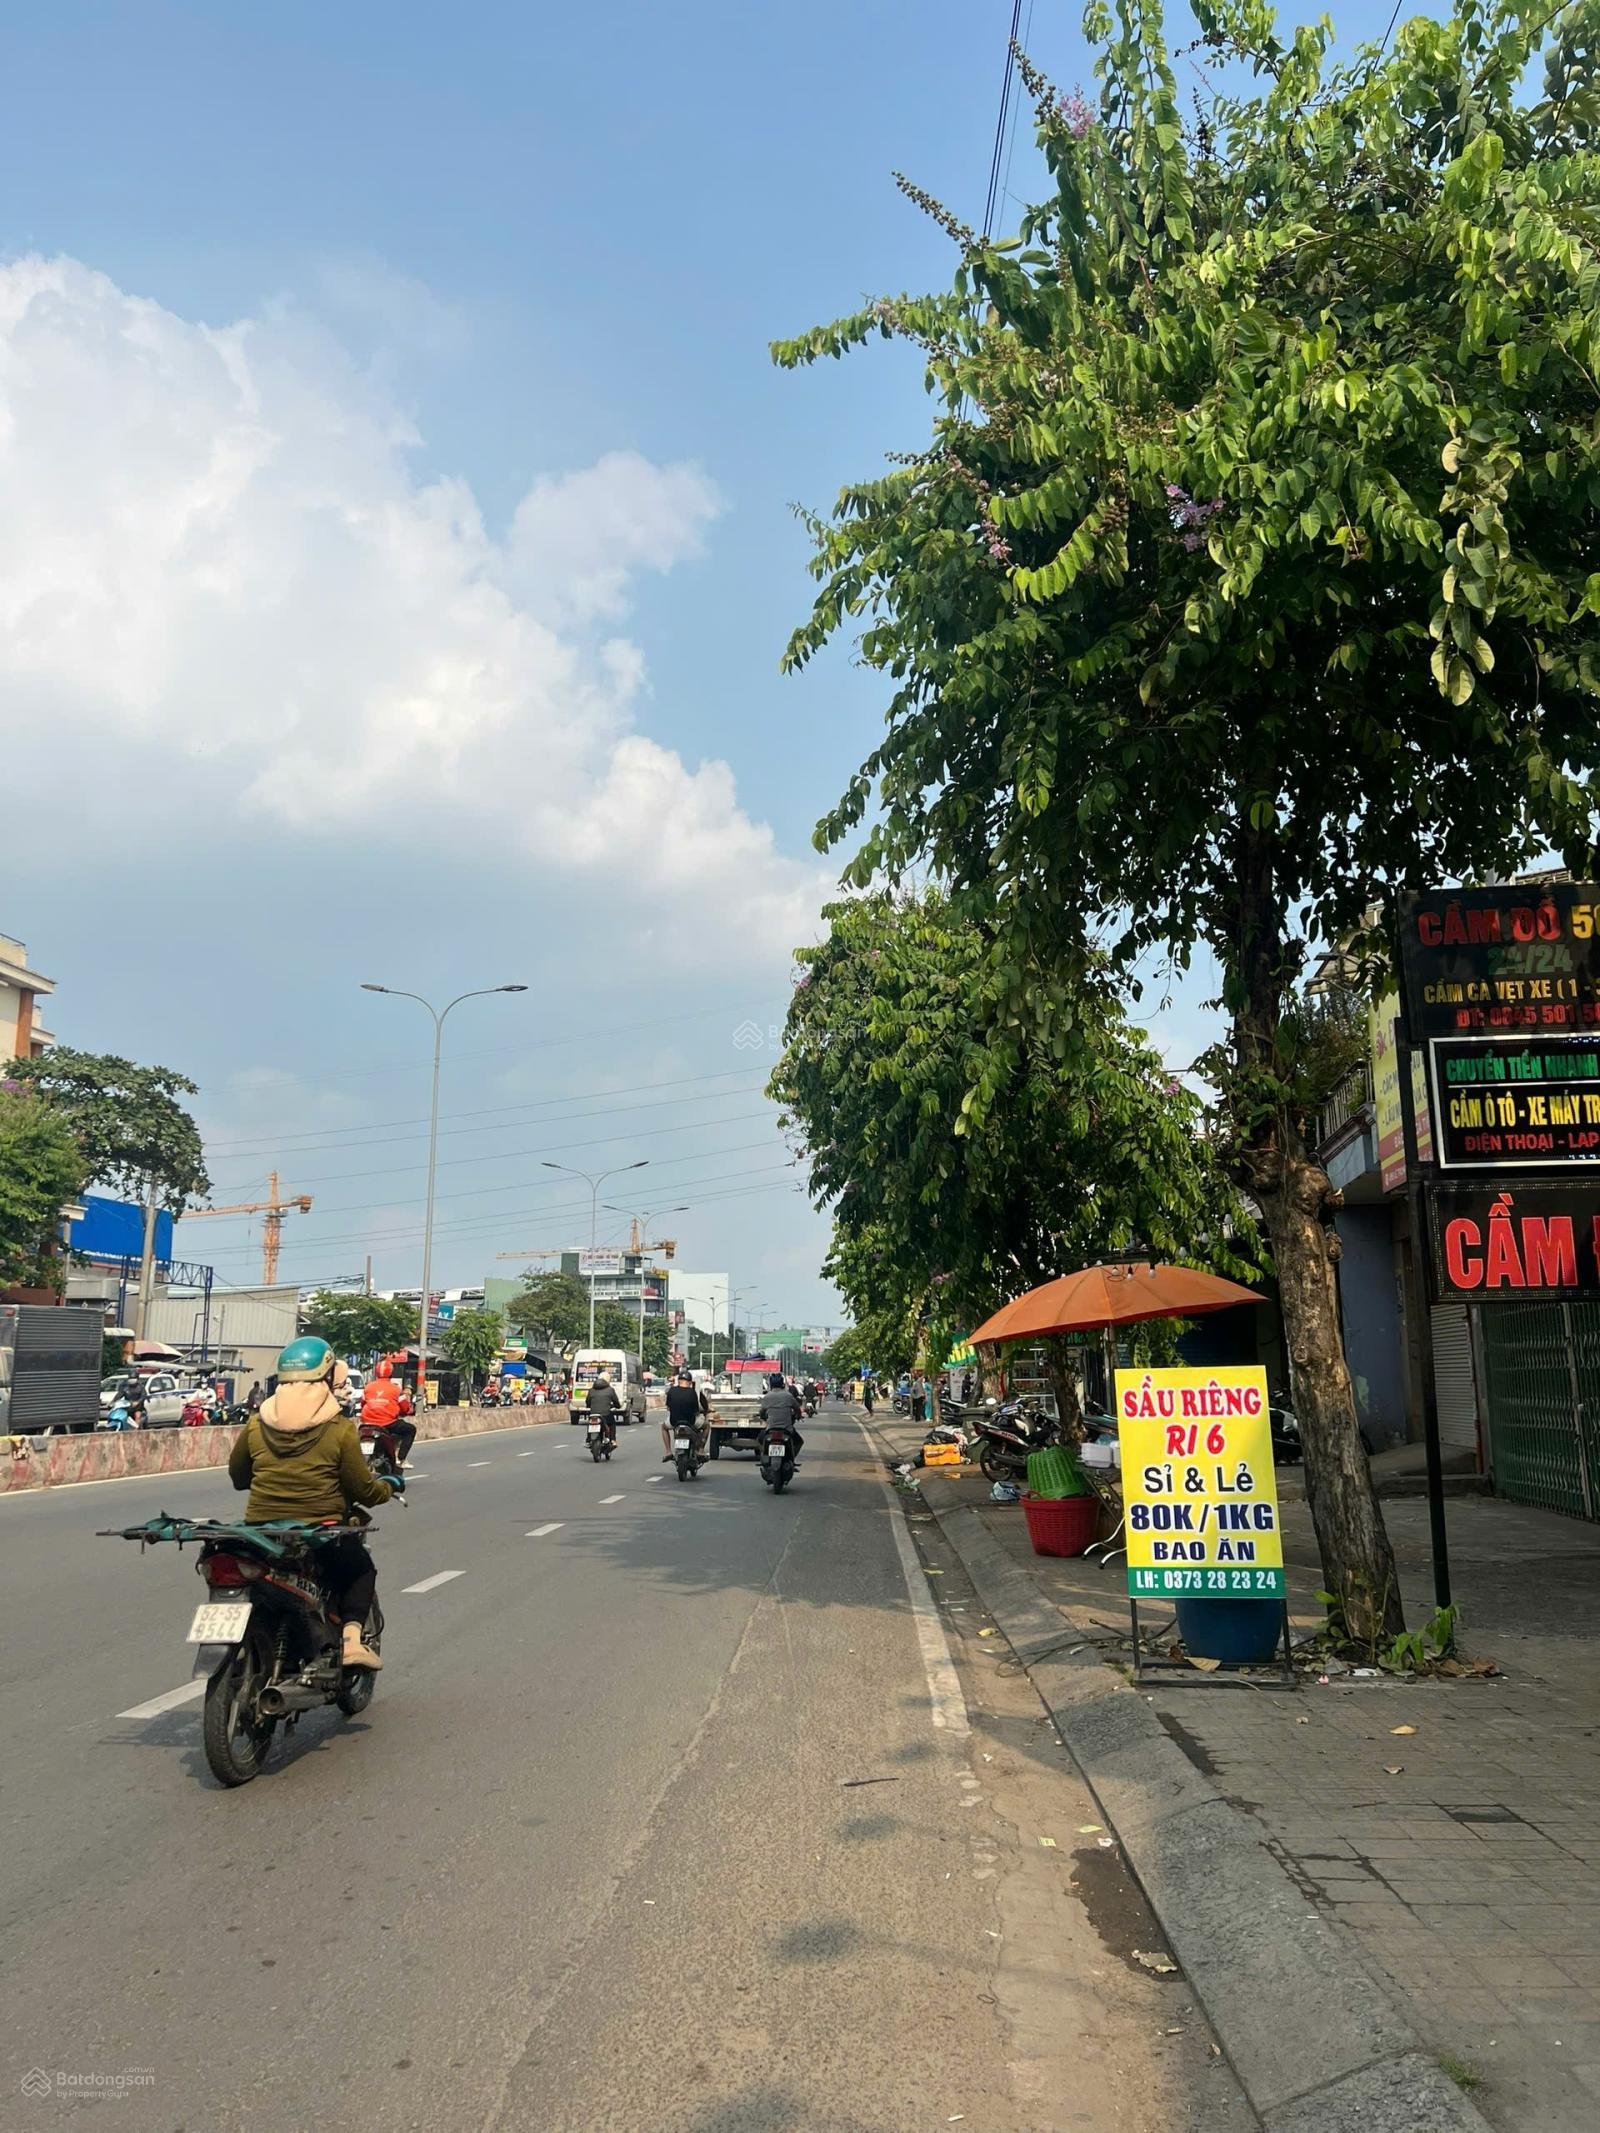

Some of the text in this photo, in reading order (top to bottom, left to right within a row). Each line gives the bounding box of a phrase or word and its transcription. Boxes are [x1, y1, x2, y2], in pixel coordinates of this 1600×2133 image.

[1571, 903, 1600, 939] 5
[1487, 944, 1573, 976] 24/24
[1494, 980, 1525, 1003] VẸT
[1529, 979, 1552, 999] XE
[1568, 978, 1578, 998] 1
[1541, 1003, 1575, 1024] 501
[1545, 1054, 1599, 1077] NHANH
[1485, 1092, 1496, 1127] Ô
[1497, 1090, 1516, 1127] TÔ
[1527, 1096, 1548, 1126] XE
[1464, 1132, 1502, 1153] ĐIỆN
[1505, 1133, 1554, 1152] THOẠI
[1568, 1132, 1600, 1149] LAP
[1445, 1192, 1579, 1289] CẦM
[1124, 1375, 1261, 1418] SẦU RIÊNG
[1207, 1424, 1225, 1454] 6
[1144, 1463, 1253, 1493] Sỉ & Lẻ
[1154, 1538, 1254, 1561] BAO ĂN
[1136, 1570, 1276, 1589] LH: 0373 28 23 24
